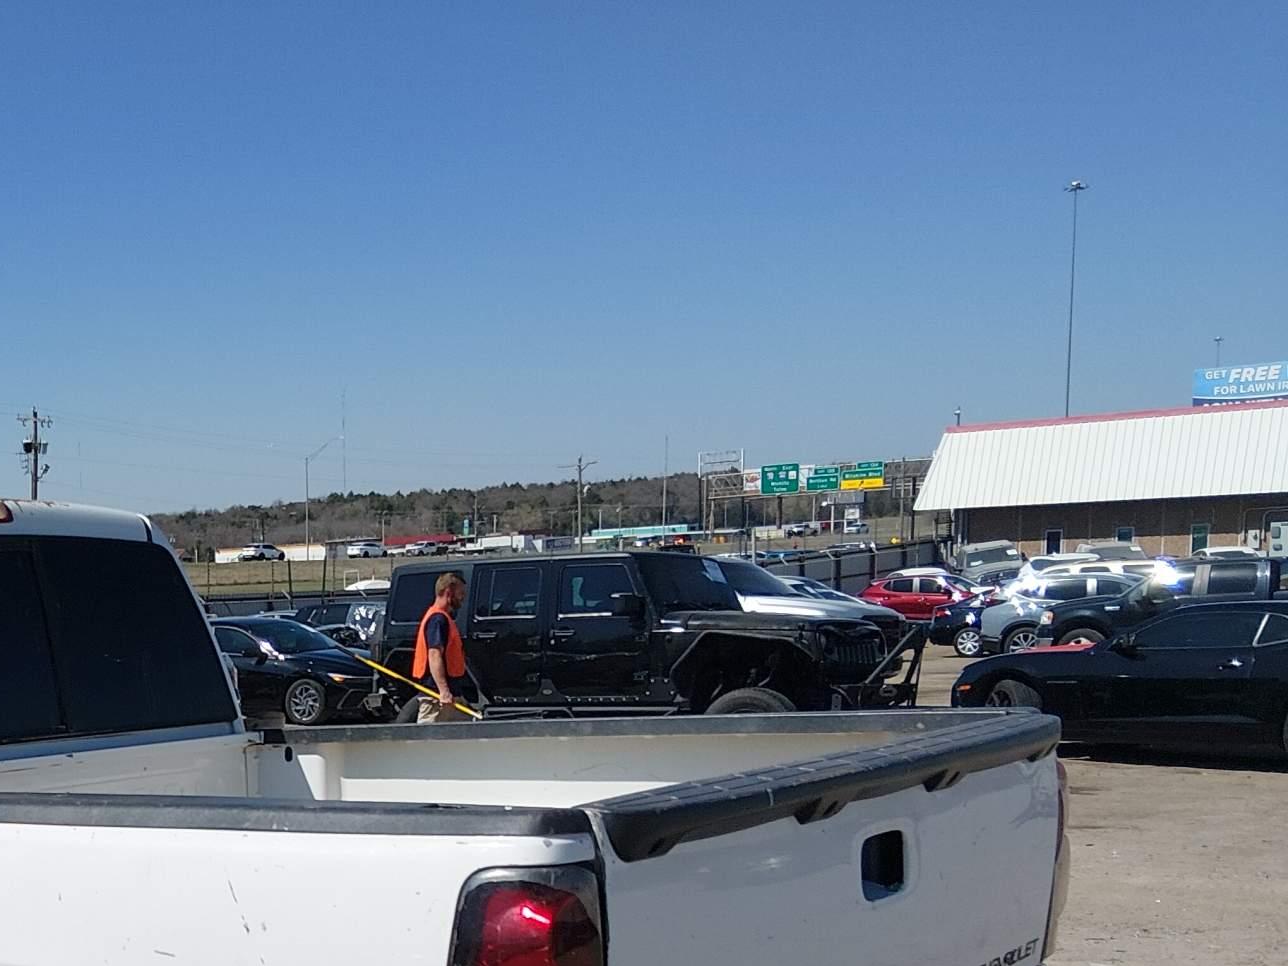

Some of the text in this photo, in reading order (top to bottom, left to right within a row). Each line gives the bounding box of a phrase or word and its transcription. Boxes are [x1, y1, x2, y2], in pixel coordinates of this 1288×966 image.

[1205, 364, 1282, 383] GET FREE
[1214, 385, 1238, 396] FOR
[1240, 382, 1275, 394] LAWN
